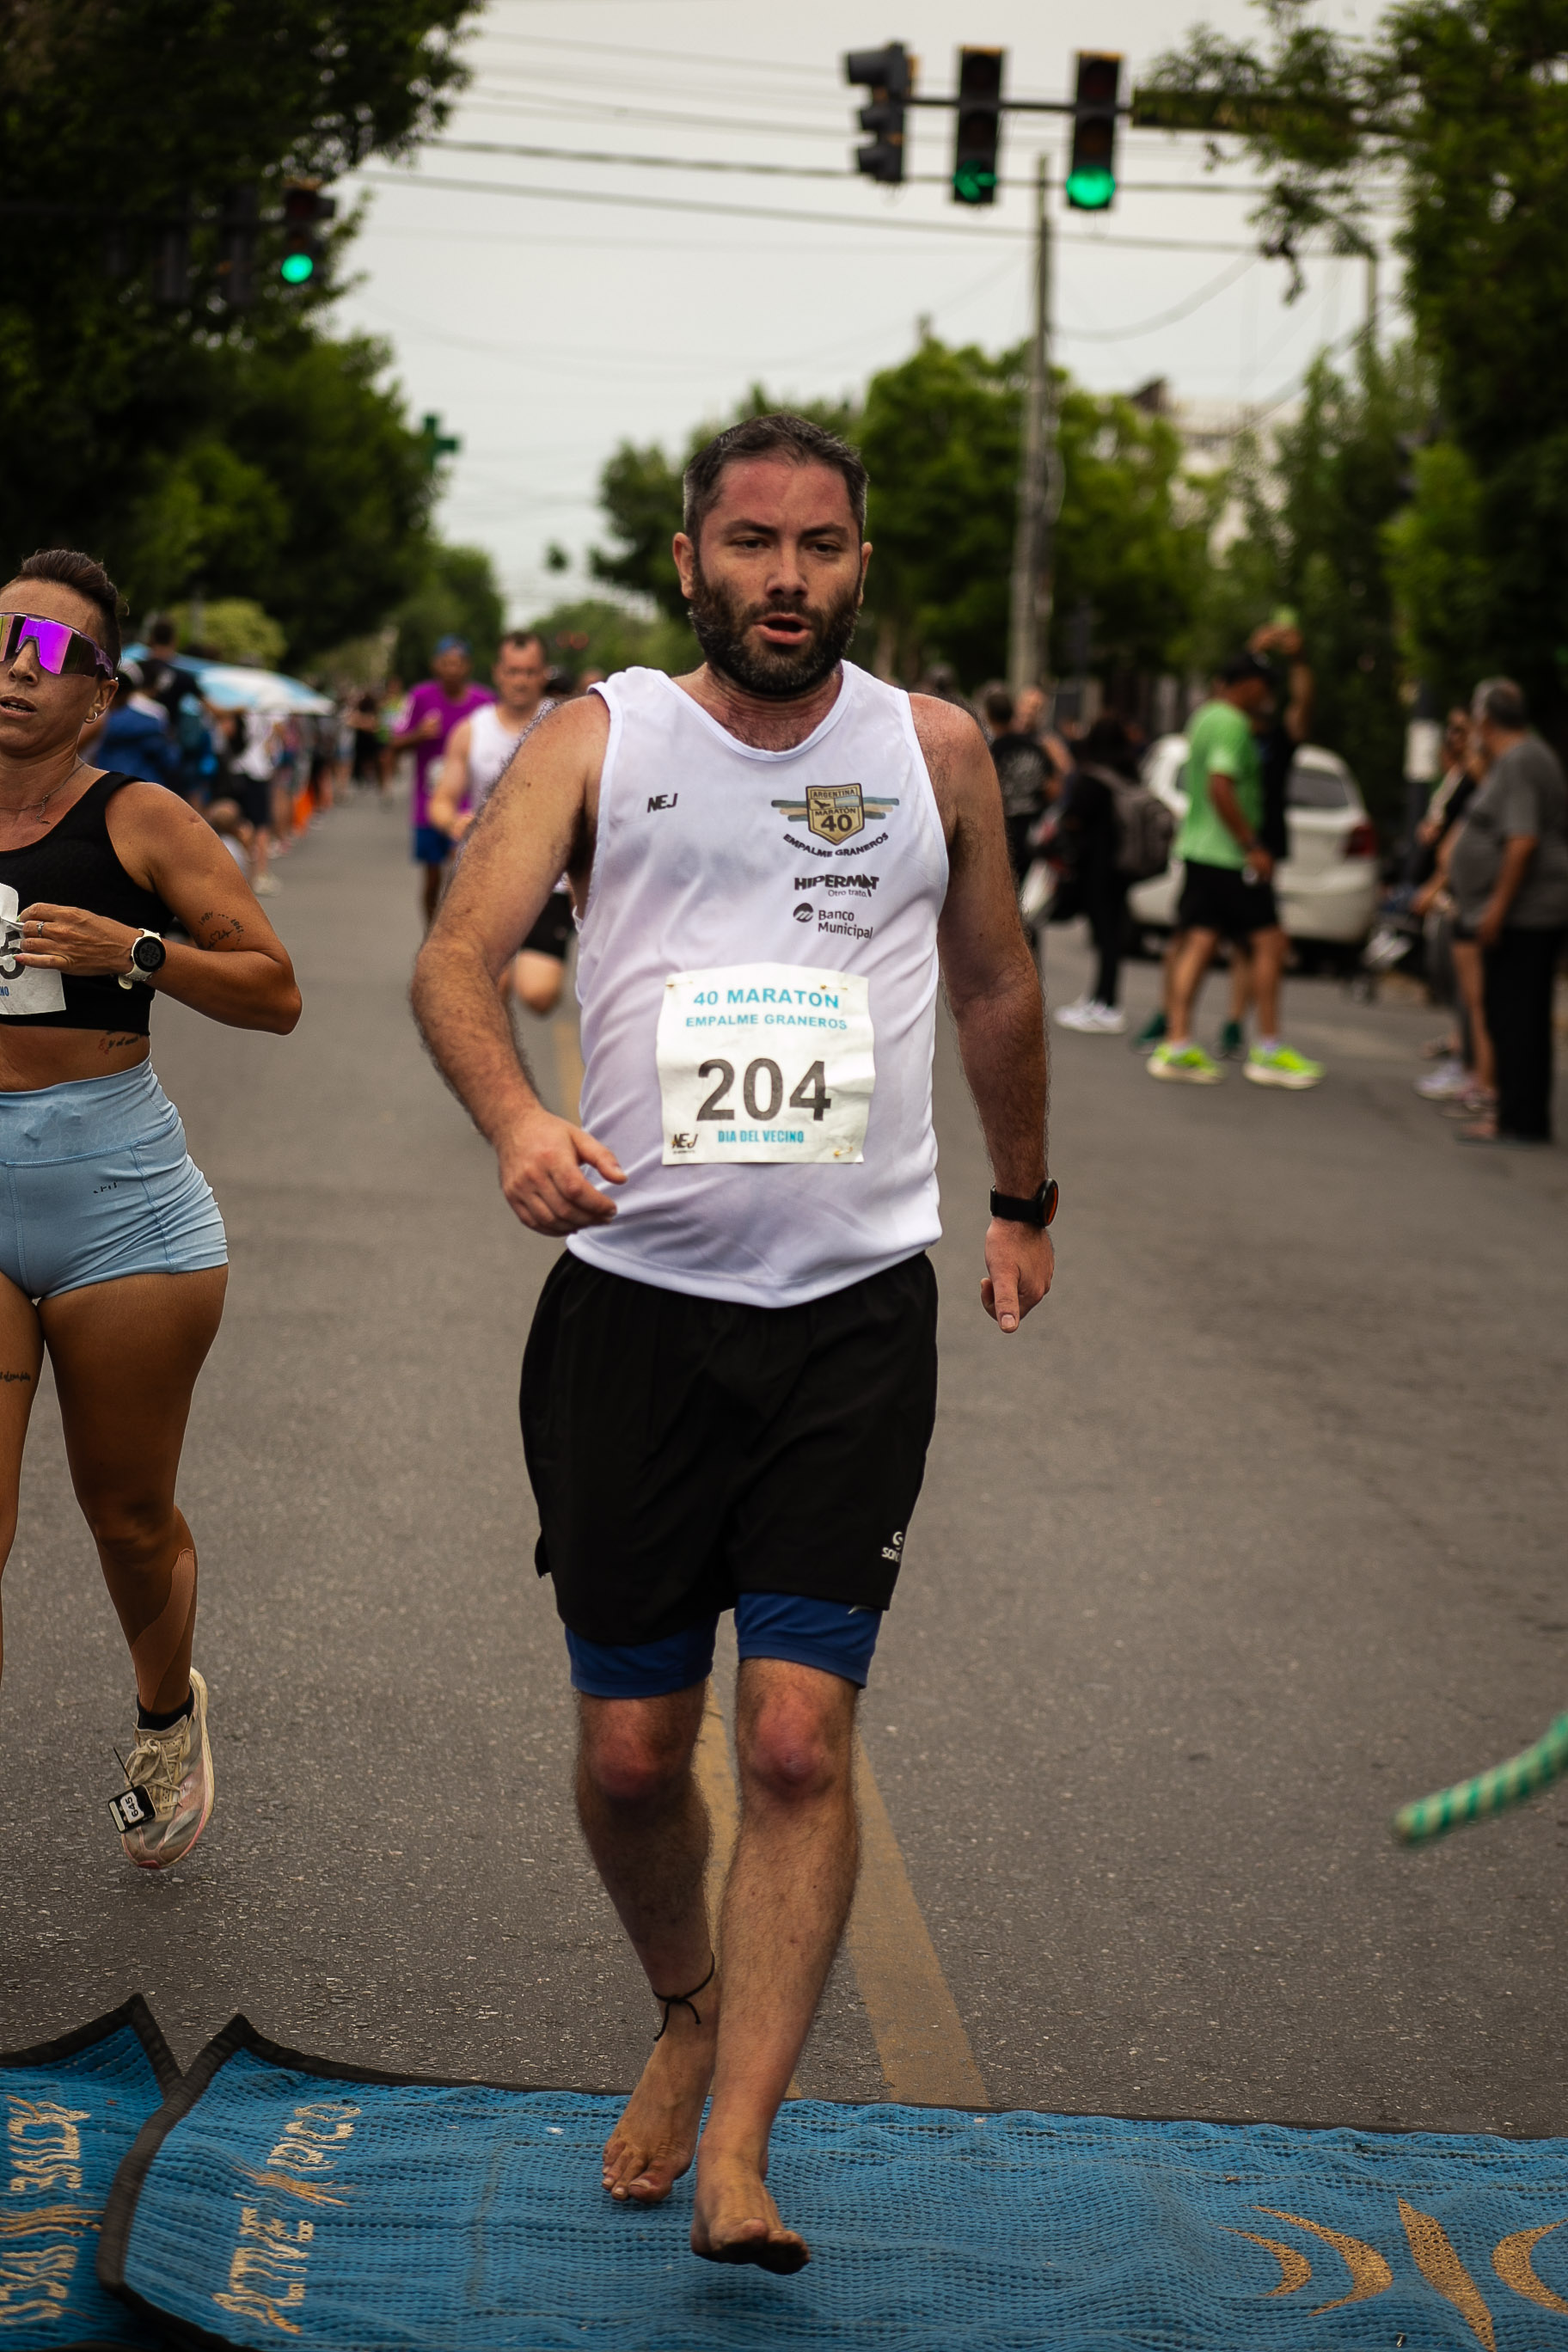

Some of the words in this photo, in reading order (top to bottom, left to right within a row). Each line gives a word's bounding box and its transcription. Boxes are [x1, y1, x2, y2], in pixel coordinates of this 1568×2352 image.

[647, 793, 678, 813] NEJ
[813, 789, 855, 799] ARGENTINA
[820, 813, 853, 832] 40
[783, 833, 833, 857] EMPALME
[835, 832, 889, 856] GRANEROS
[818, 910, 854, 922] Banco
[818, 922, 873, 940] Municipal
[693, 990, 719, 1006] 40
[726, 988, 839, 1009] MARATON
[685, 1014, 759, 1027] EMPALME
[764, 1014, 848, 1030] GRANEROS
[695, 1057, 832, 1122] 204
[671, 1132, 699, 1148] NEJ
[718, 1130, 737, 1143] DIA
[740, 1130, 759, 1143] DEL
[763, 1130, 805, 1144] VECINO
[125, 1796, 139, 1817] 645
